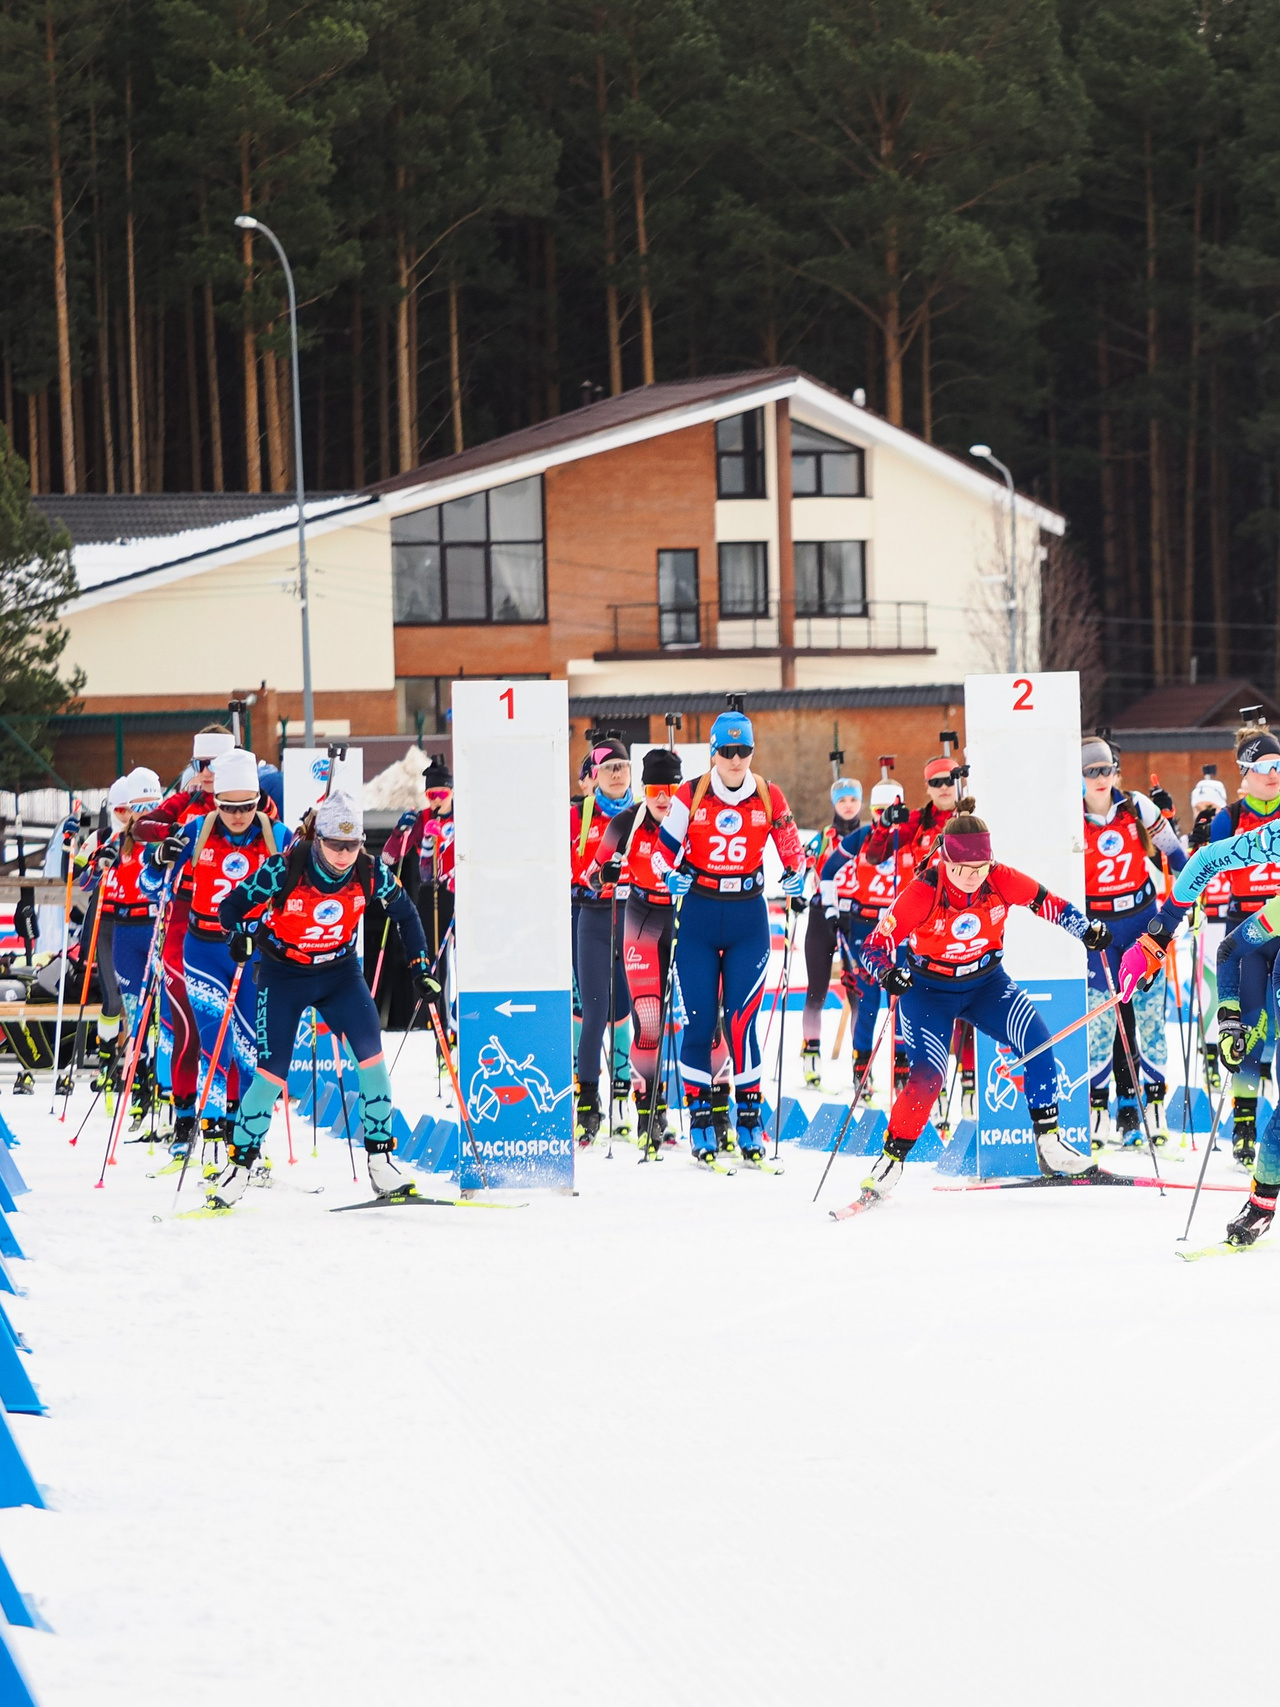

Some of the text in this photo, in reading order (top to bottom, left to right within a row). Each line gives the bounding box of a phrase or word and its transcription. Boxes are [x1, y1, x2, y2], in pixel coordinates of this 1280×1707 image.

[499, 688, 515, 720] 1
[1011, 679, 1034, 712] 2
[708, 835, 748, 863] 26
[1096, 852, 1133, 883] 27
[299, 925, 344, 941] 21
[376, 1142, 389, 1151] 171
[980, 1126, 1089, 1146] КРАСНРСК
[462, 1139, 571, 1158] КРАСНОЯРСК
